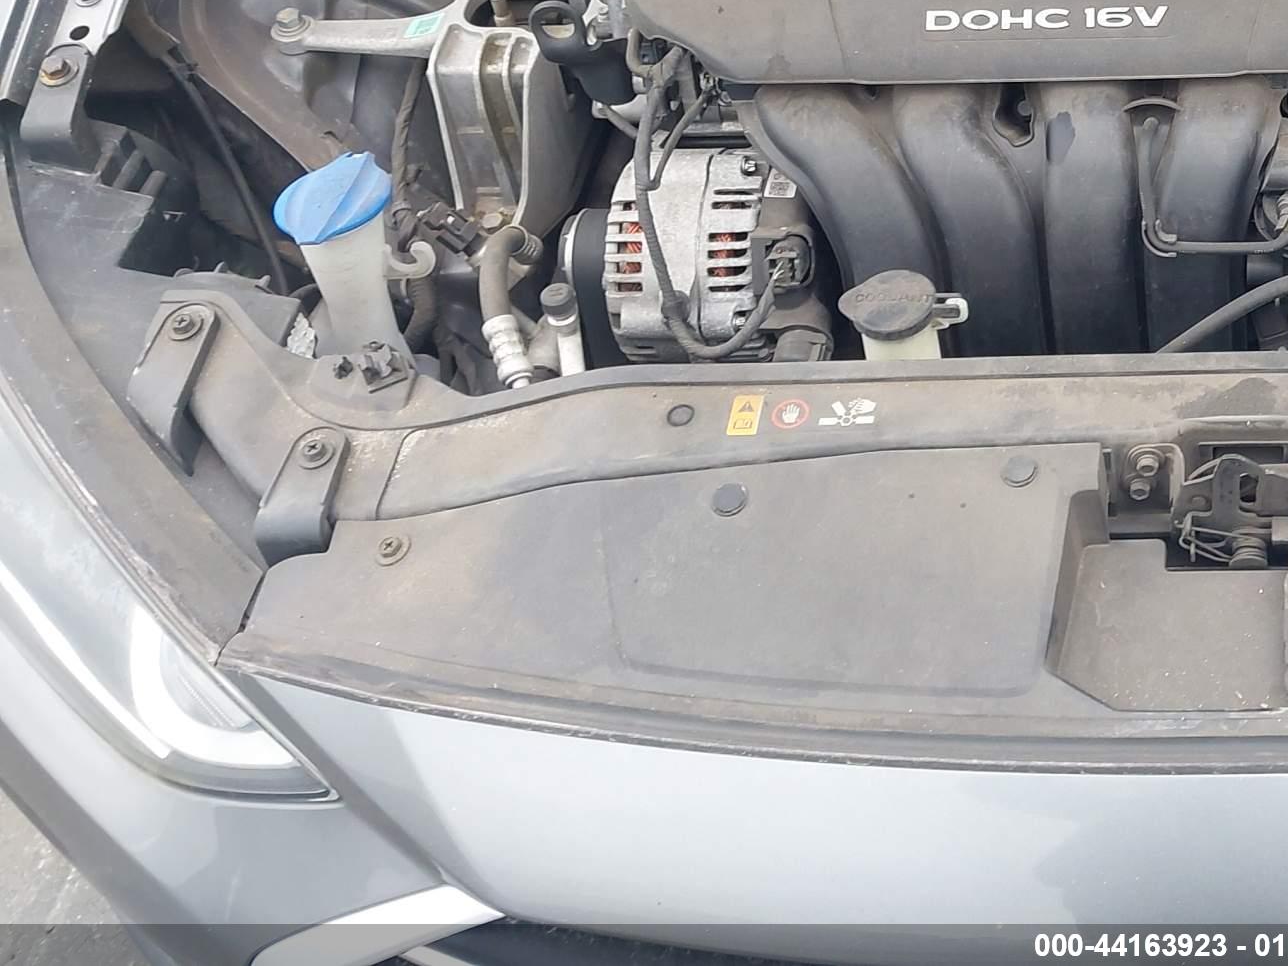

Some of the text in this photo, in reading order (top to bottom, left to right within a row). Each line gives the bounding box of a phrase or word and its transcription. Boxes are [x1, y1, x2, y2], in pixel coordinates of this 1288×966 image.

[925, 5, 1169, 32] DOHC 16V
[855, 292, 934, 304] COOLANT
